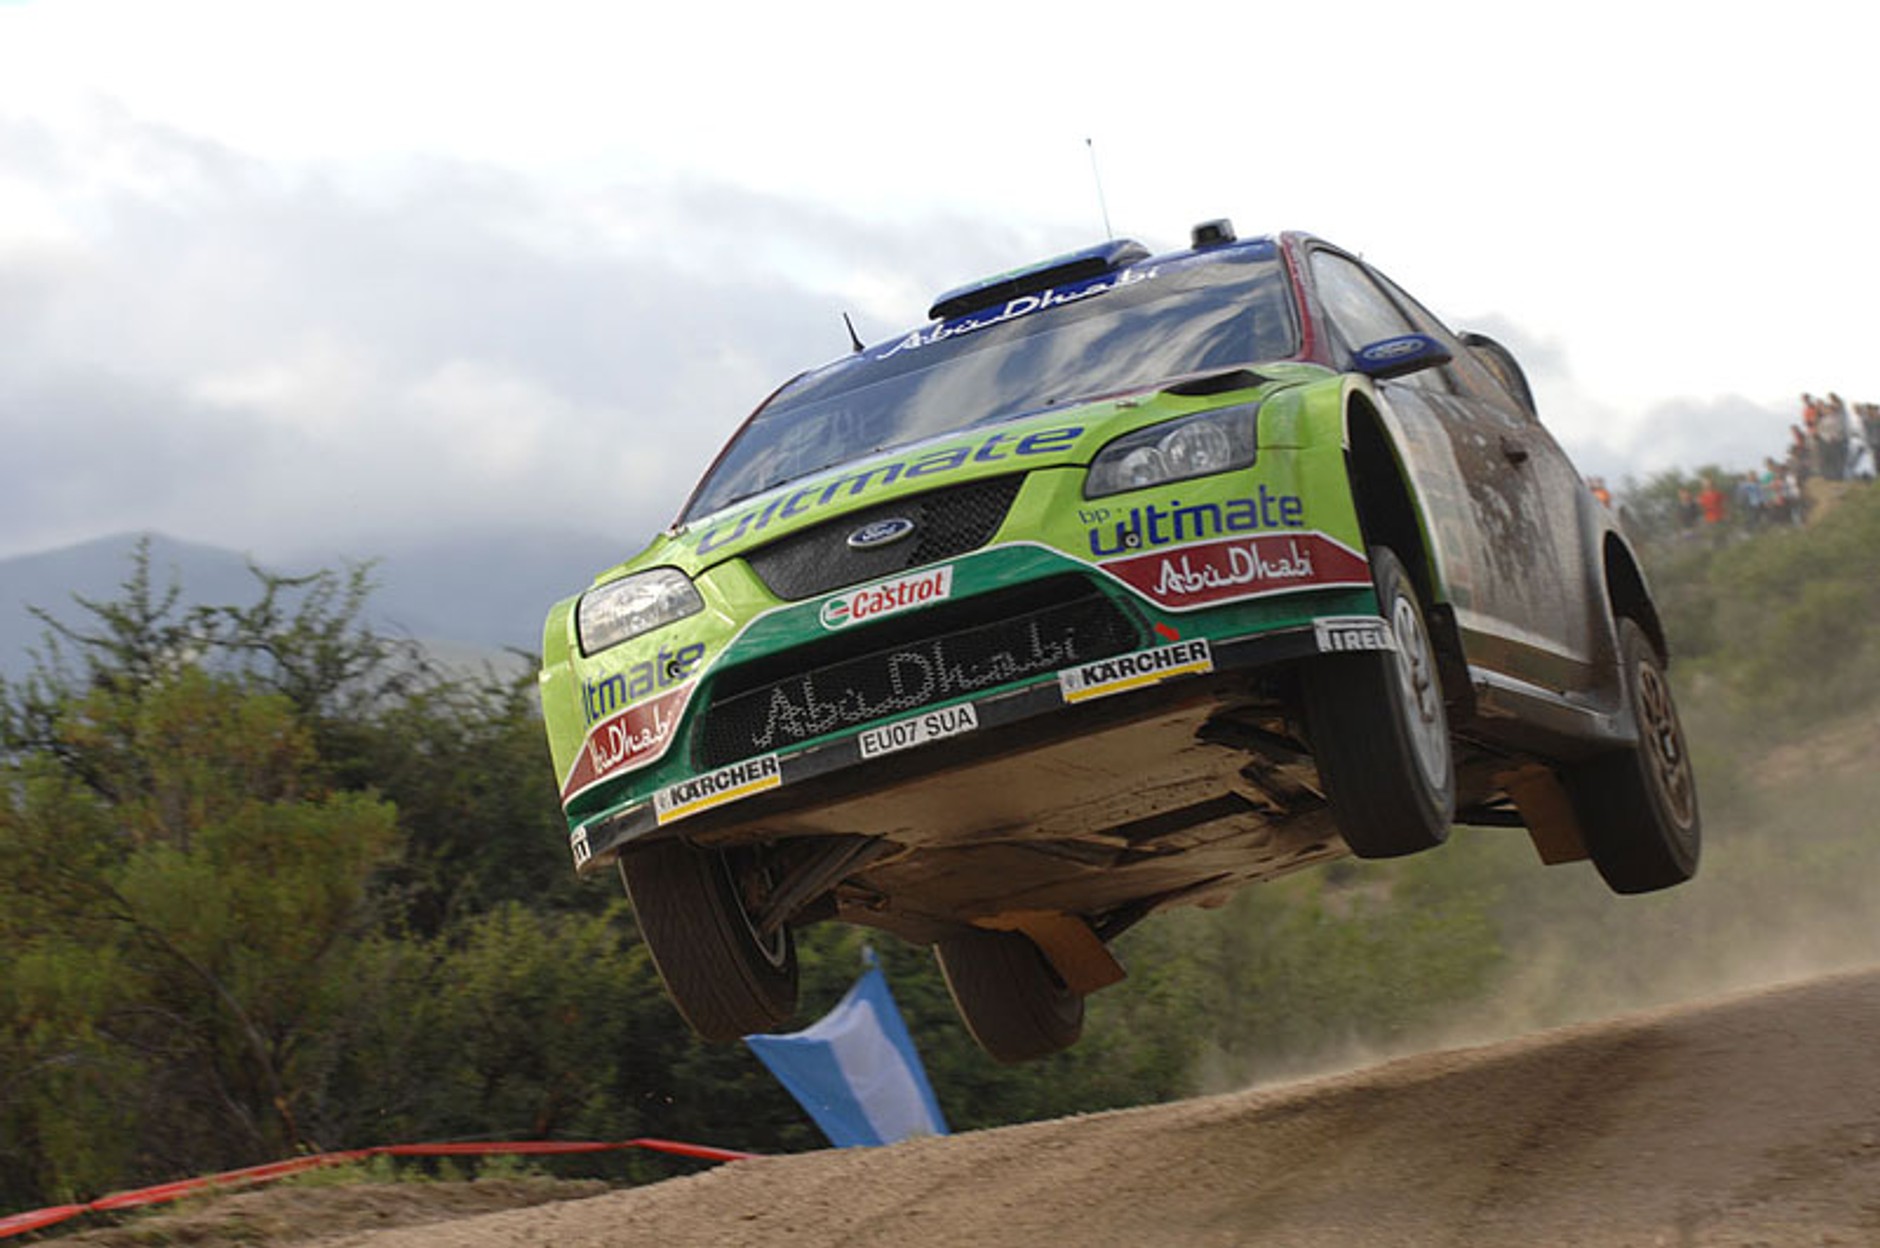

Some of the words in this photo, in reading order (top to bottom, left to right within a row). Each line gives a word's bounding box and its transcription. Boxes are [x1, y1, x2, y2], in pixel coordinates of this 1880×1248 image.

[1000, 266, 1158, 318] Dhabi
[696, 426, 1085, 555] ultimate
[1078, 508, 1111, 525] bp
[1089, 484, 1303, 556] ultimate
[852, 571, 944, 619] Castrol
[1153, 555, 1232, 596] Abu
[1228, 539, 1315, 584] Dhabi
[583, 641, 706, 728] ltimate
[752, 673, 892, 749] Abu
[886, 622, 1080, 708] Dhabi
[862, 721, 917, 755] EU07
[925, 707, 974, 736] SUA
